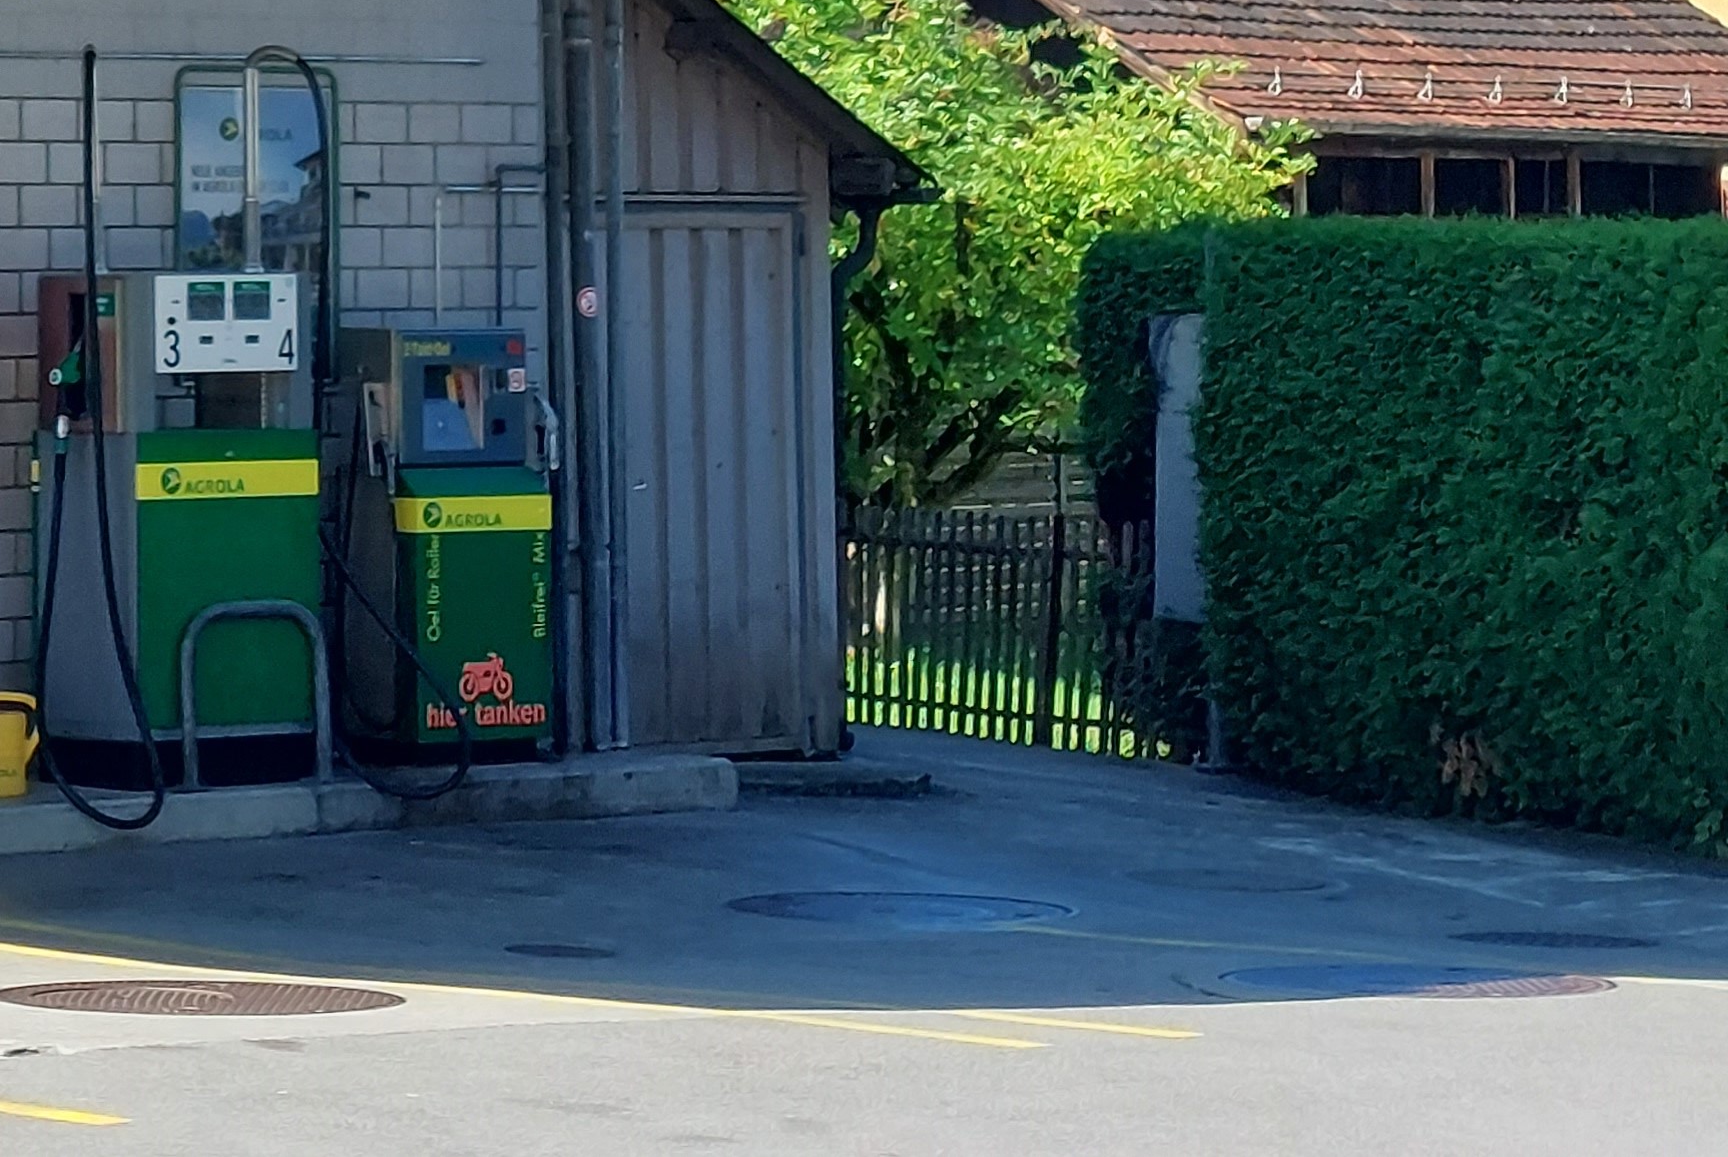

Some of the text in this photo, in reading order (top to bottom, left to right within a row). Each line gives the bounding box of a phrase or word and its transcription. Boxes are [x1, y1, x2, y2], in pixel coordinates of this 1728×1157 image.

[163, 329, 180, 368] 3
[278, 328, 295, 365] 4
[184, 478, 245, 494] AGROLA
[444, 513, 503, 528] AGROLA
[474, 698, 546, 726] tanken
